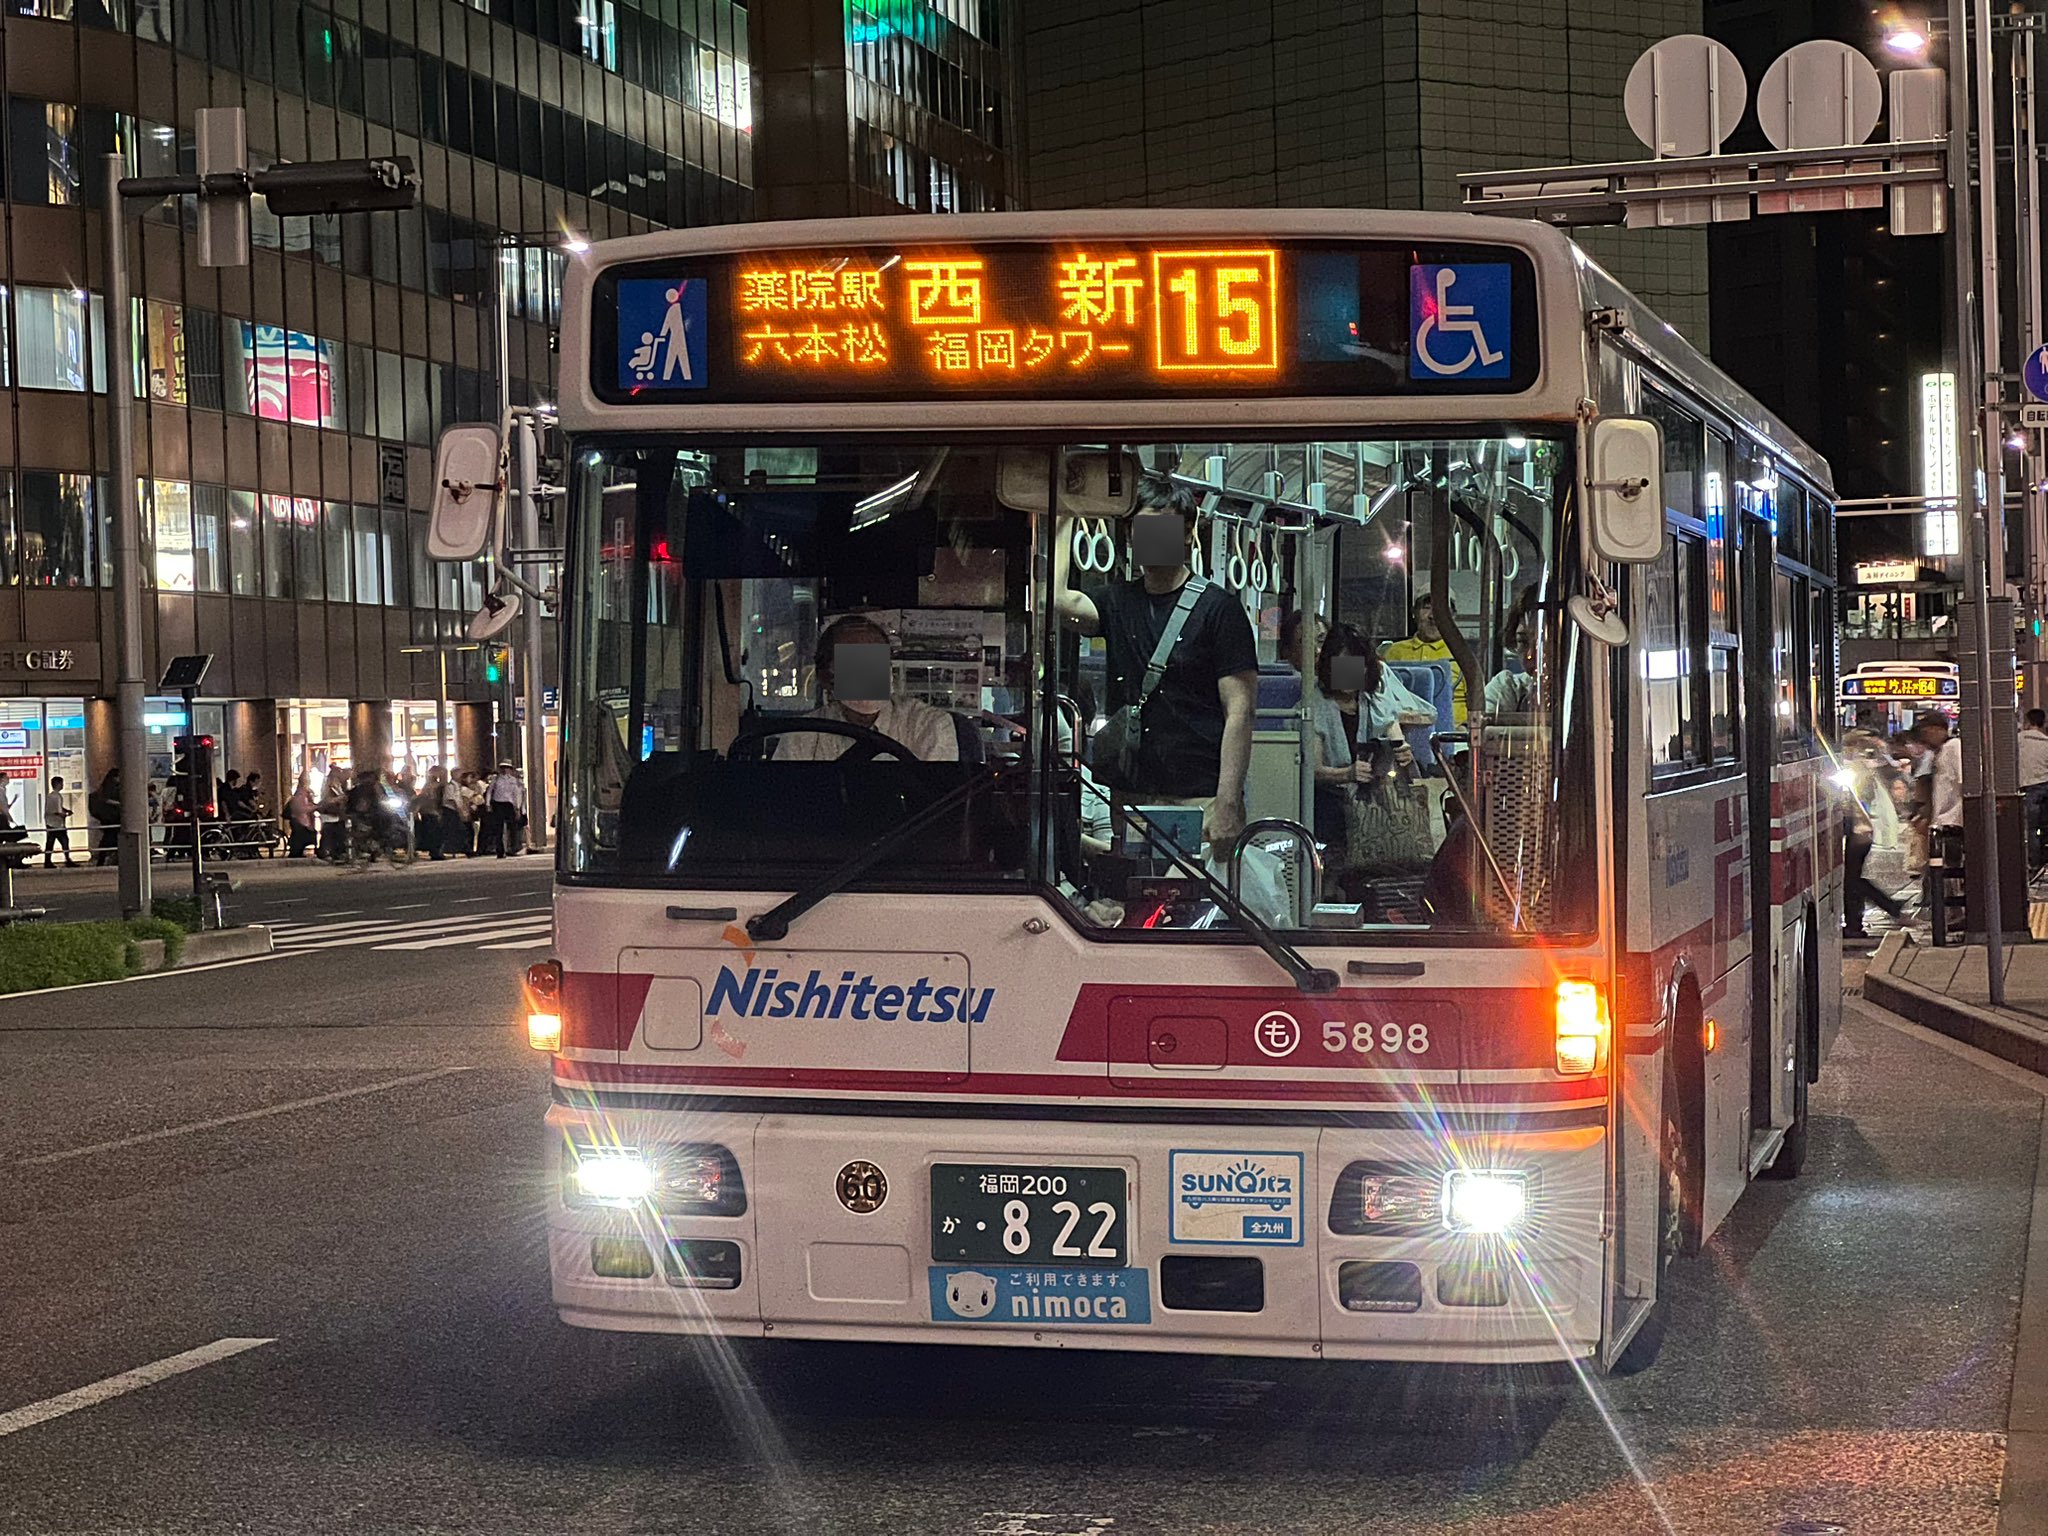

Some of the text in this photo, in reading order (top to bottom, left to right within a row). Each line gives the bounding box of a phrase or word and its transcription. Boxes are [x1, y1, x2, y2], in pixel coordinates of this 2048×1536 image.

[741, 270, 885, 310] 薬院駅
[1169, 268, 1262, 355] 15
[743, 323, 888, 363] 六本松
[926, 328, 1131, 370] 福岡タワー
[2027, 410, 2048, 422] 自転
[704, 964, 996, 1023] Nishitetsu
[1322, 1021, 1430, 1055] 5898
[843, 1174, 882, 1201] 60
[942, 1216, 962, 1234] か
[1250, 1221, 1285, 1234] 全九州
[1009, 1272, 1127, 1288] ご利用できます。
[1011, 1287, 1127, 1319] nimoca
